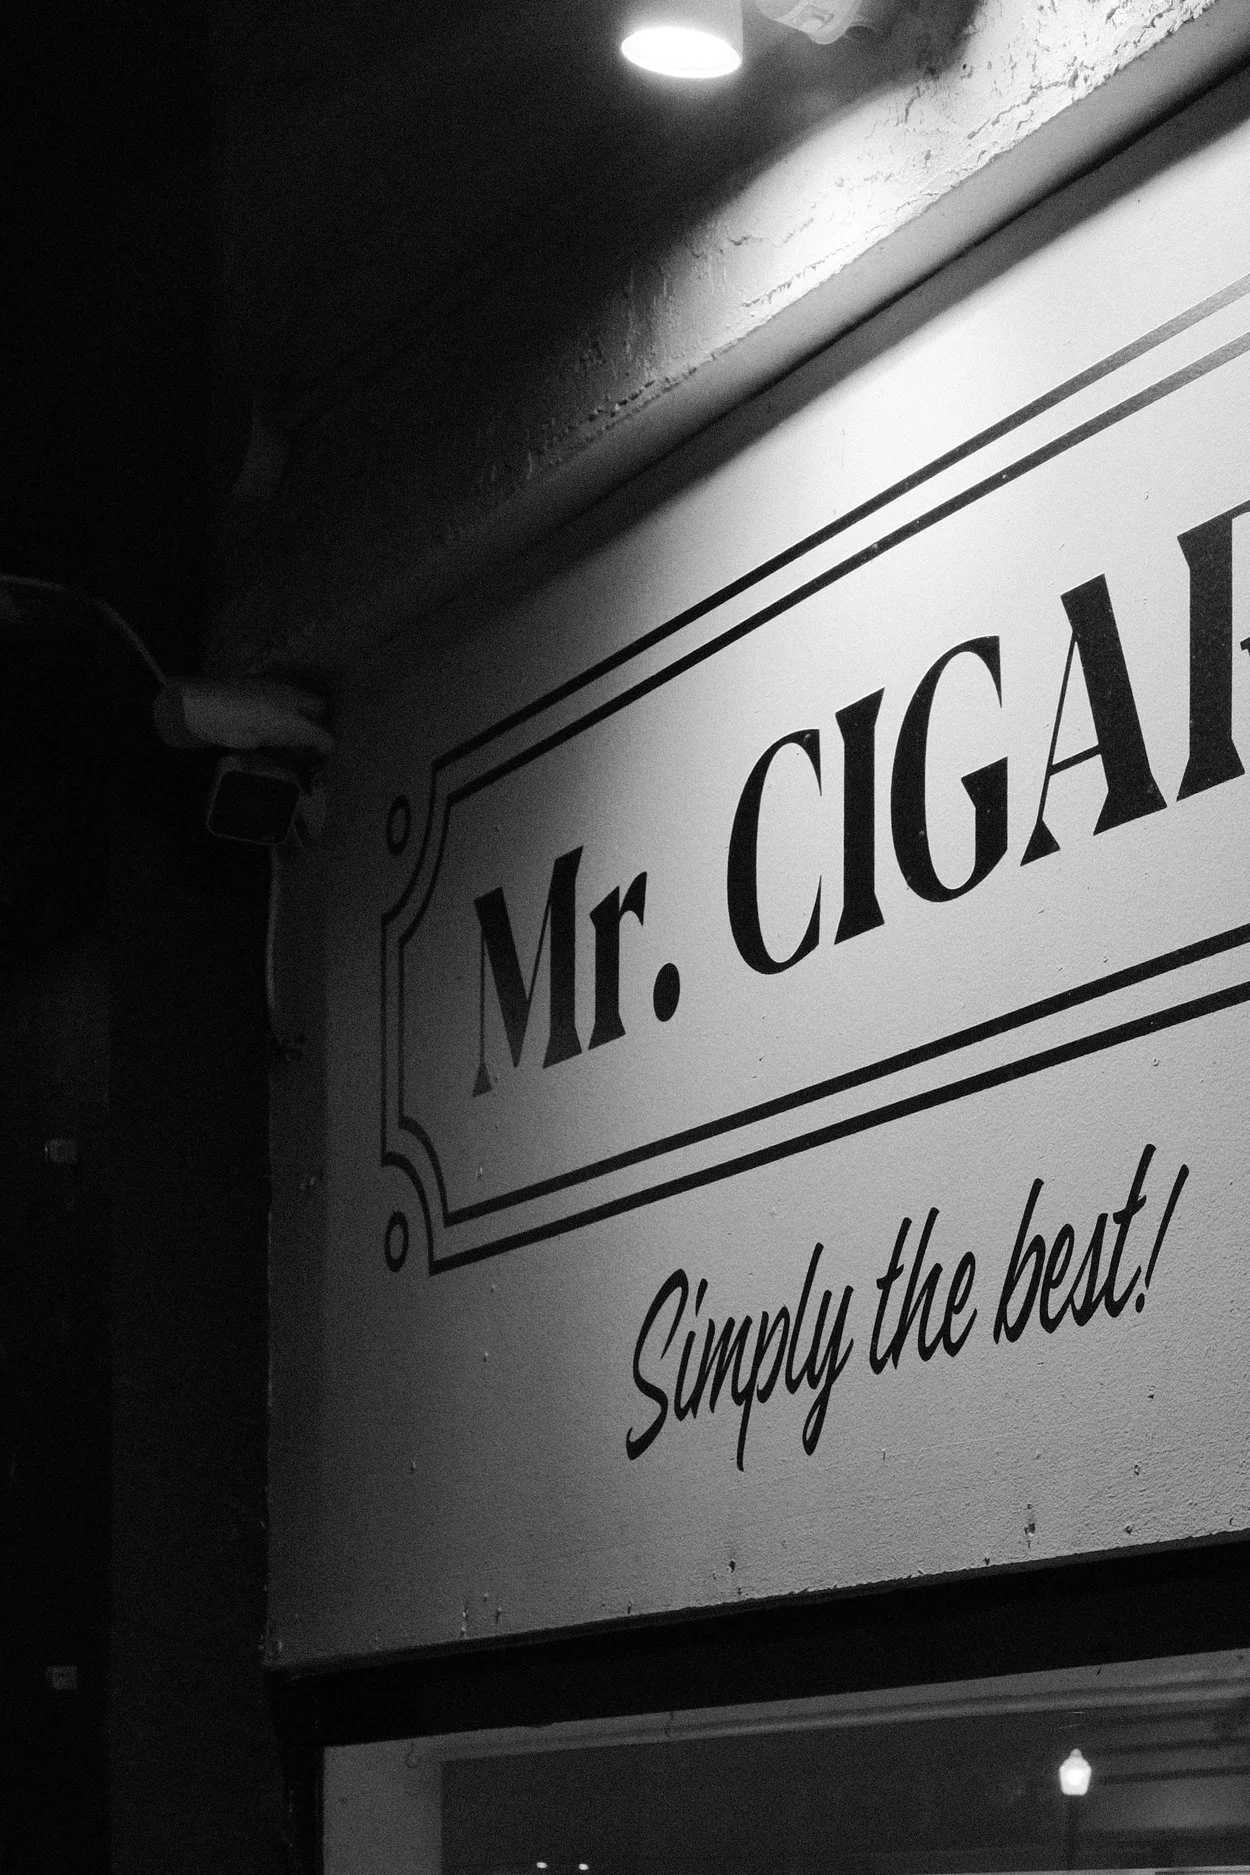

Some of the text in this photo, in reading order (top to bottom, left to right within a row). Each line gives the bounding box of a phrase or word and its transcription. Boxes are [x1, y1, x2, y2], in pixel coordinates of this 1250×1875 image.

[471, 844, 680, 1099] Mr.
[625, 1142, 1189, 1472] Simply the best!
